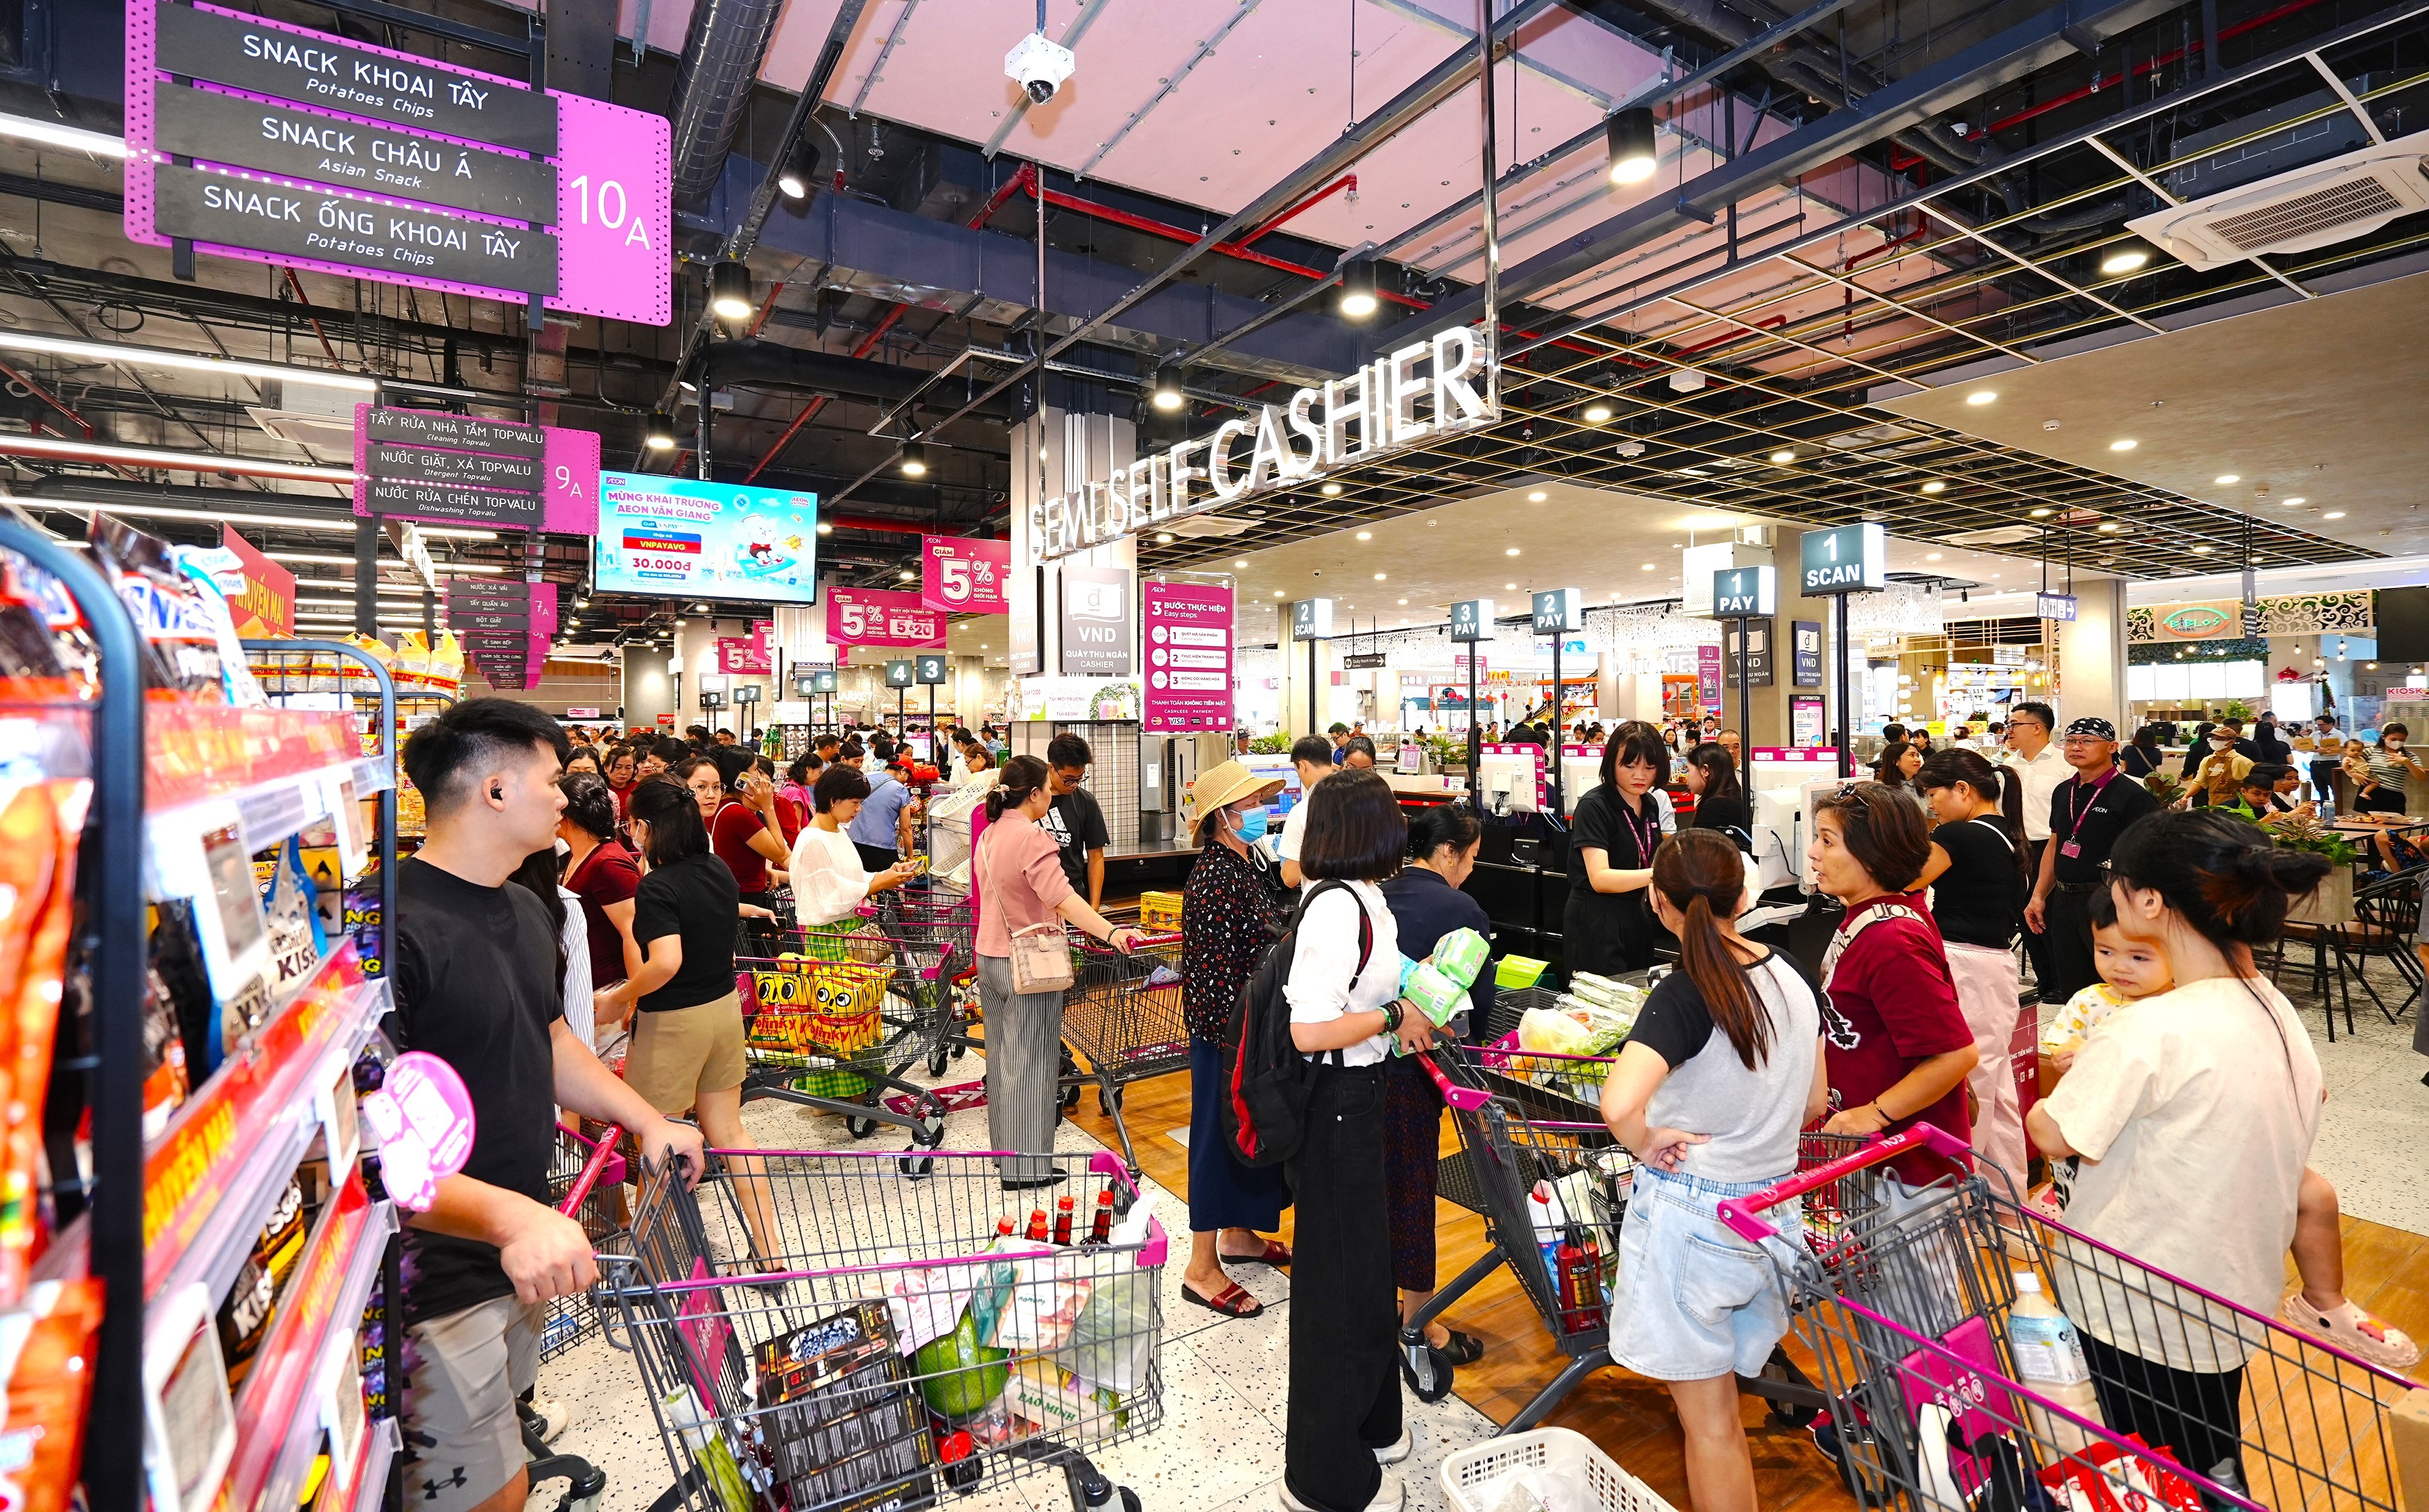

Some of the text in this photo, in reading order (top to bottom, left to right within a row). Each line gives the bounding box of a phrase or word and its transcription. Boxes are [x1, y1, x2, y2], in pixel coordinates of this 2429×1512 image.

[243, 35, 488, 110] SNACK KHOAI TÂY
[306, 78, 435, 119] Potatoes Chips
[262, 116, 472, 180] SNACK CHÂU Á
[318, 158, 421, 189] Asian Snack
[204, 185, 520, 259] SNACK ỐNG KHOAI TÂY
[306, 232, 435, 267] Potatoes Chips
[370, 411, 543, 444] TẨY RỬA NHÀ TẮM TOPVALU
[427, 434, 490, 447] Cleaning Topvalu
[1030, 326, 1488, 559] SEMI SELF CASHIER
[381, 451, 531, 476] NƯỚC GIẶT, XẢ TOPVALU
[424, 469, 491, 481] Dtergent Topvalu
[376, 487, 536, 511] NƯỚC RỬA CHÉN TOPVALU
[609, 491, 720, 510] MỪNG KHAI TRƯƠNG
[419, 504, 496, 517] Dishwashing Topvalu
[618, 505, 711, 520] AEON VĂN GIANG
[640, 541, 685, 550] VNPAYAVG
[1823, 533, 1837, 561] 1
[633, 558, 691, 571] 30.000đ
[1731, 573, 1741, 593] 1
[1806, 564, 1860, 587] SCAN
[1151, 601, 1162, 616] 3
[1187, 603, 1207, 612] THỰC
[1209, 605, 1226, 613] HIỆN
[1544, 594, 1556, 612] 2
[1720, 596, 1754, 611] PAY
[1300, 604, 1309, 621] 2
[1461, 605, 1471, 621] 3
[1538, 613, 1563, 627] PAY
[897, 621, 905, 633] 5
[1078, 626, 1116, 642] VND
[1295, 623, 1314, 635] SCAN
[1455, 623, 1477, 635] PAY
[1016, 628, 1032, 644] VND
[1106, 650, 1128, 659] NGÂN
[925, 661, 939, 678] 3
[1802, 658, 1816, 668] VND
[894, 666, 906, 681] 4
[803, 680, 811, 693] 6
[821, 675, 832, 688] 5
[711, 694, 717, 702] 9
[738, 690, 745, 700] 8
[749, 688, 757, 698] 7
[1045, 1403, 1077, 1421] MINH
